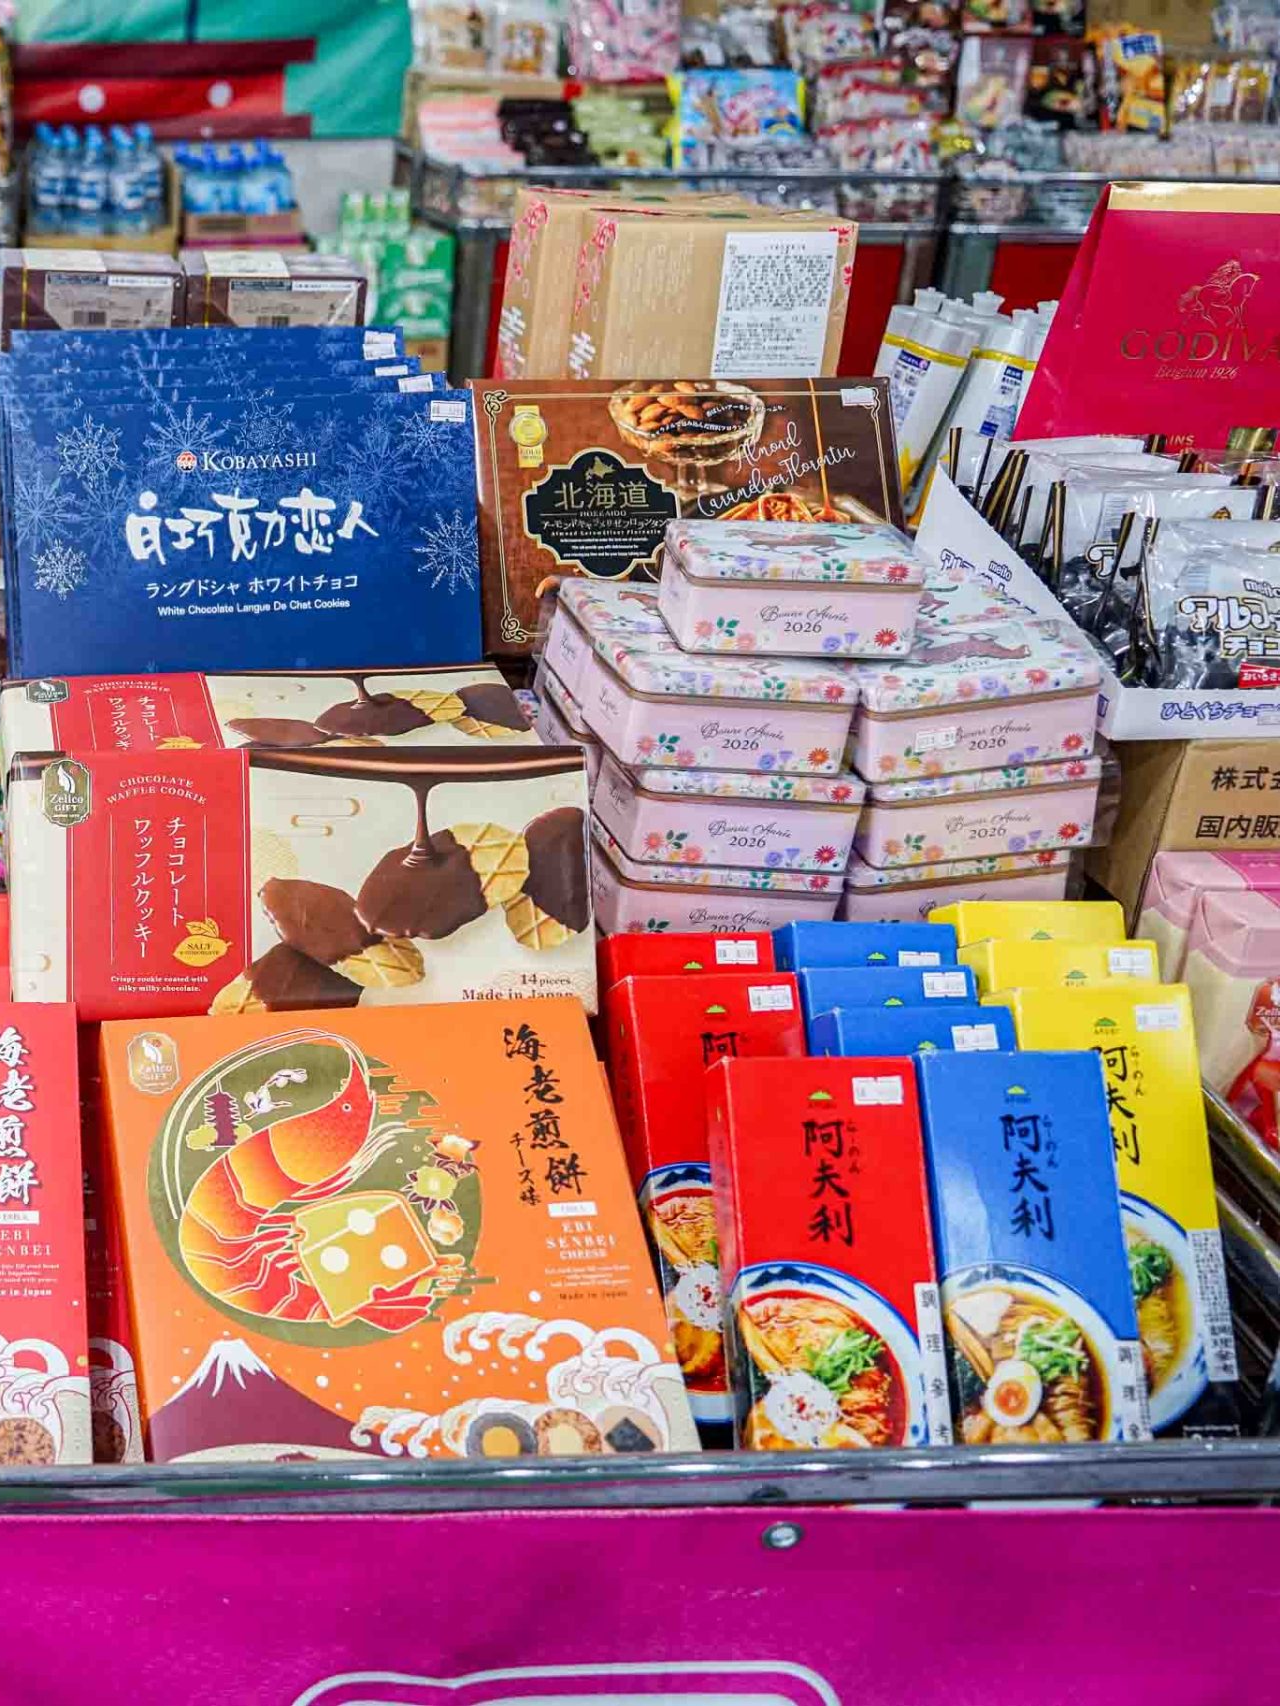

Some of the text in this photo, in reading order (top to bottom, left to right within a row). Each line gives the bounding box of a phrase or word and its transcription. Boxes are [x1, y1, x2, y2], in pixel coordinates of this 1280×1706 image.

[202, 451, 317, 472] KOBAYASHI
[553, 480, 650, 512] 北海道
[248, 574, 359, 595] ホワイトチョコ
[157, 606, 186, 617] White
[187, 604, 235, 616] Chocolate
[236, 602, 271, 615] Langue
[289, 600, 313, 611] Chat
[314, 598, 351, 610] Cookies
[783, 621, 823, 634] 2026
[721, 737, 760, 751] 2026
[969, 736, 1007, 751] 2026
[119, 774, 195, 789] CHOCOLATE
[106, 786, 208, 806] WAFFLE COOKIE
[727, 834, 767, 849] 2026
[969, 825, 1008, 841] 2026
[165, 815, 188, 929] チョコレート
[130, 816, 156, 960] ワッフルクッキー
[519, 974, 572, 988] 14 pieces
[462, 988, 506, 1001] Made
[508, 988, 523, 1001] in
[502, 1022, 589, 1196] 海老煎餅
[801, 1119, 854, 1248] 阿夫利
[999, 1113, 1056, 1242] 阿夫利
[0, 1229, 31, 1241] EBI
[22, 1287, 52, 1298] Japan
